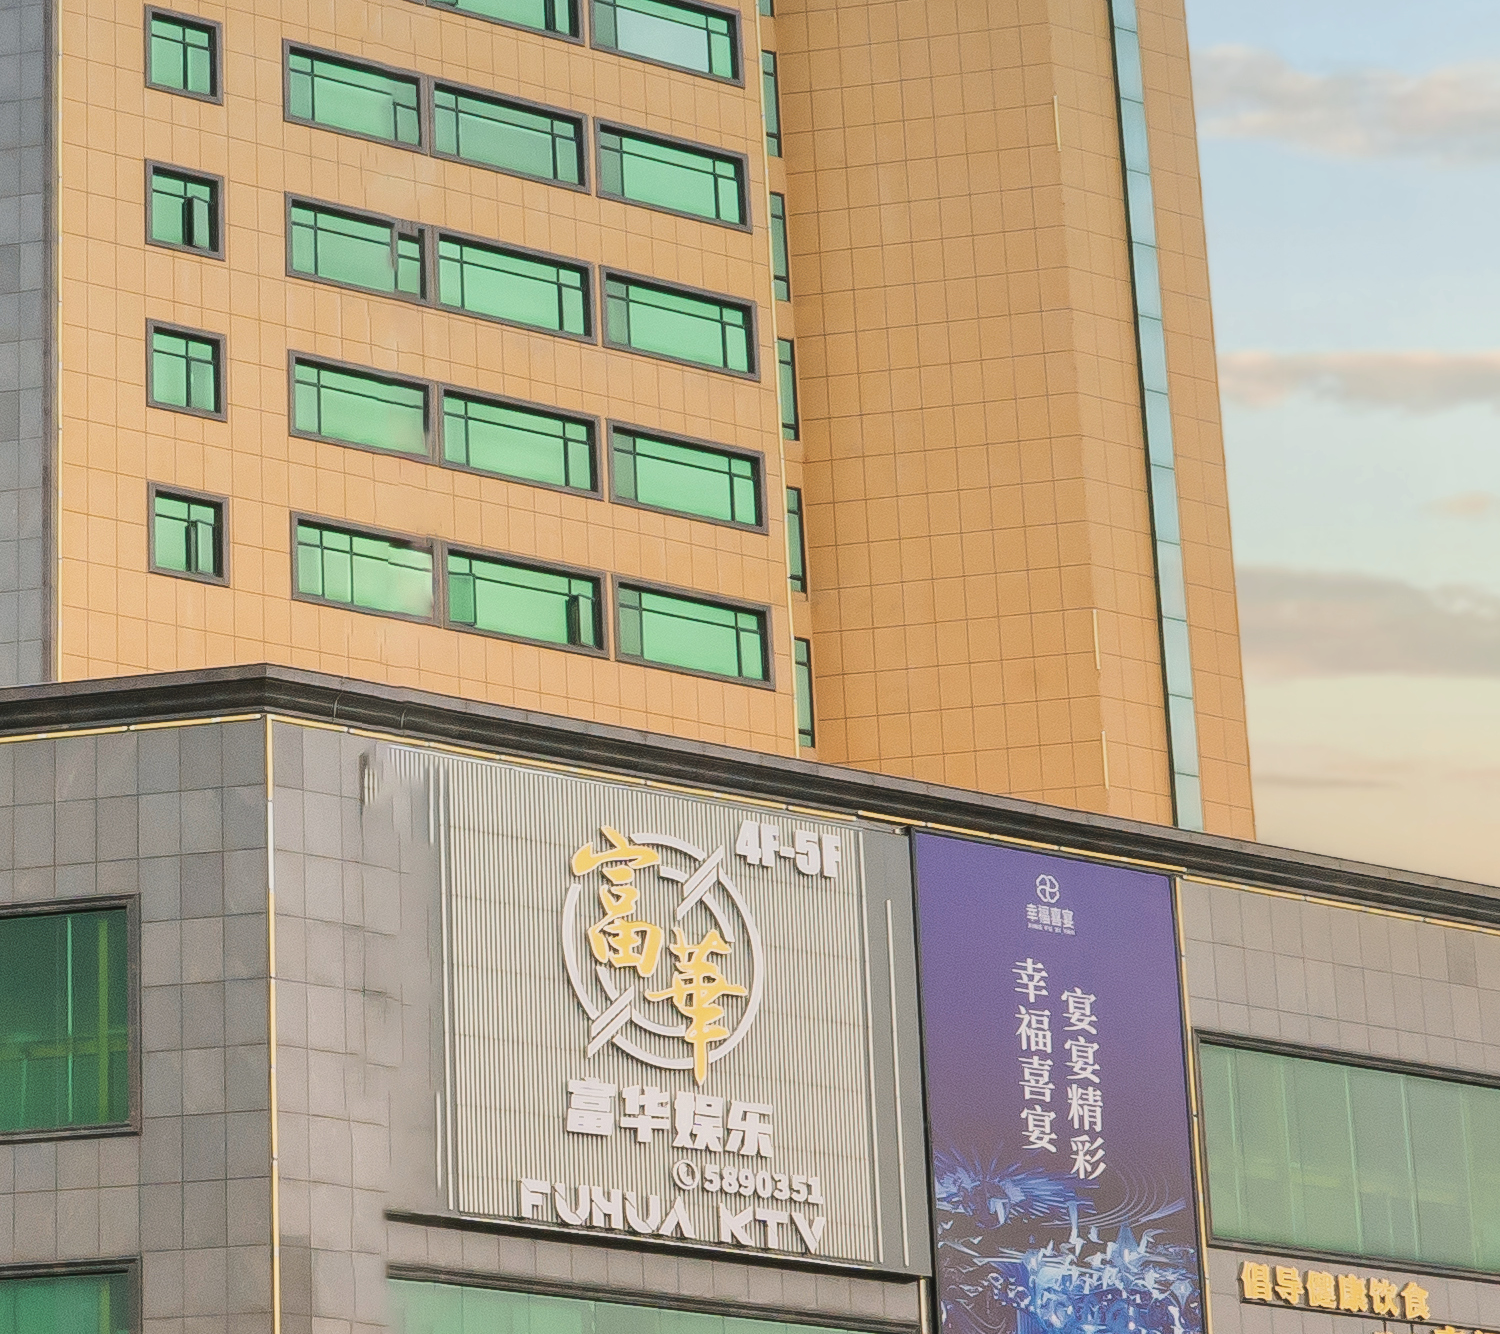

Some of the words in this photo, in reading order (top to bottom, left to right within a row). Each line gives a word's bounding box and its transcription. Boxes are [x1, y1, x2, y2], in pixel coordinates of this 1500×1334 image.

[735, 819, 841, 878] 4F-5F
[571, 825, 749, 1086] 富華
[1012, 957, 1059, 1154] 幸福喜宴
[1061, 987, 1107, 1181] 宴宴精彩
[566, 1076, 774, 1159] 富华娱乐
[519, 1178, 696, 1238] FUHUA
[720, 1202, 827, 1254] KTV
[703, 1164, 825, 1206] 5890351
[1240, 1260, 1431, 1320] 倡导健康饮食
